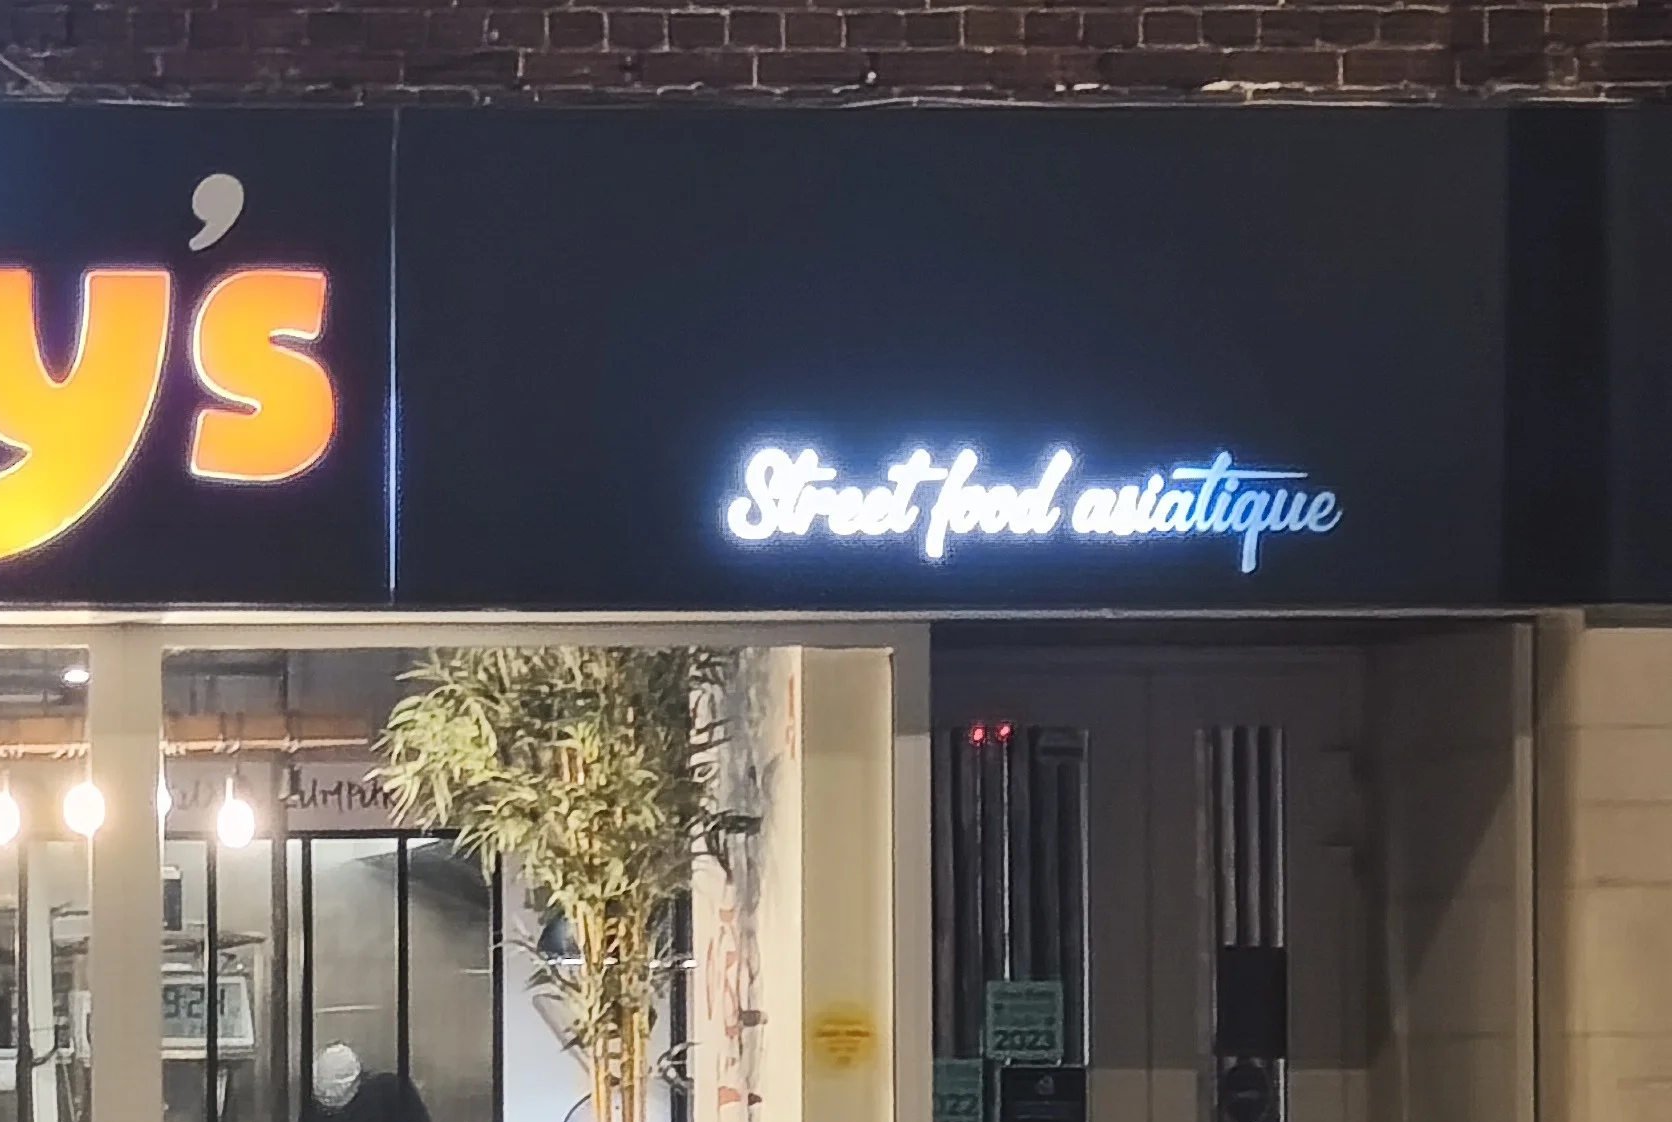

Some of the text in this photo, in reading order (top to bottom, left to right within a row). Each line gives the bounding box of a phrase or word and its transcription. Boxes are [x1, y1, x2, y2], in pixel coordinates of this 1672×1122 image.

[727, 447, 1343, 573] Street food asiatique
